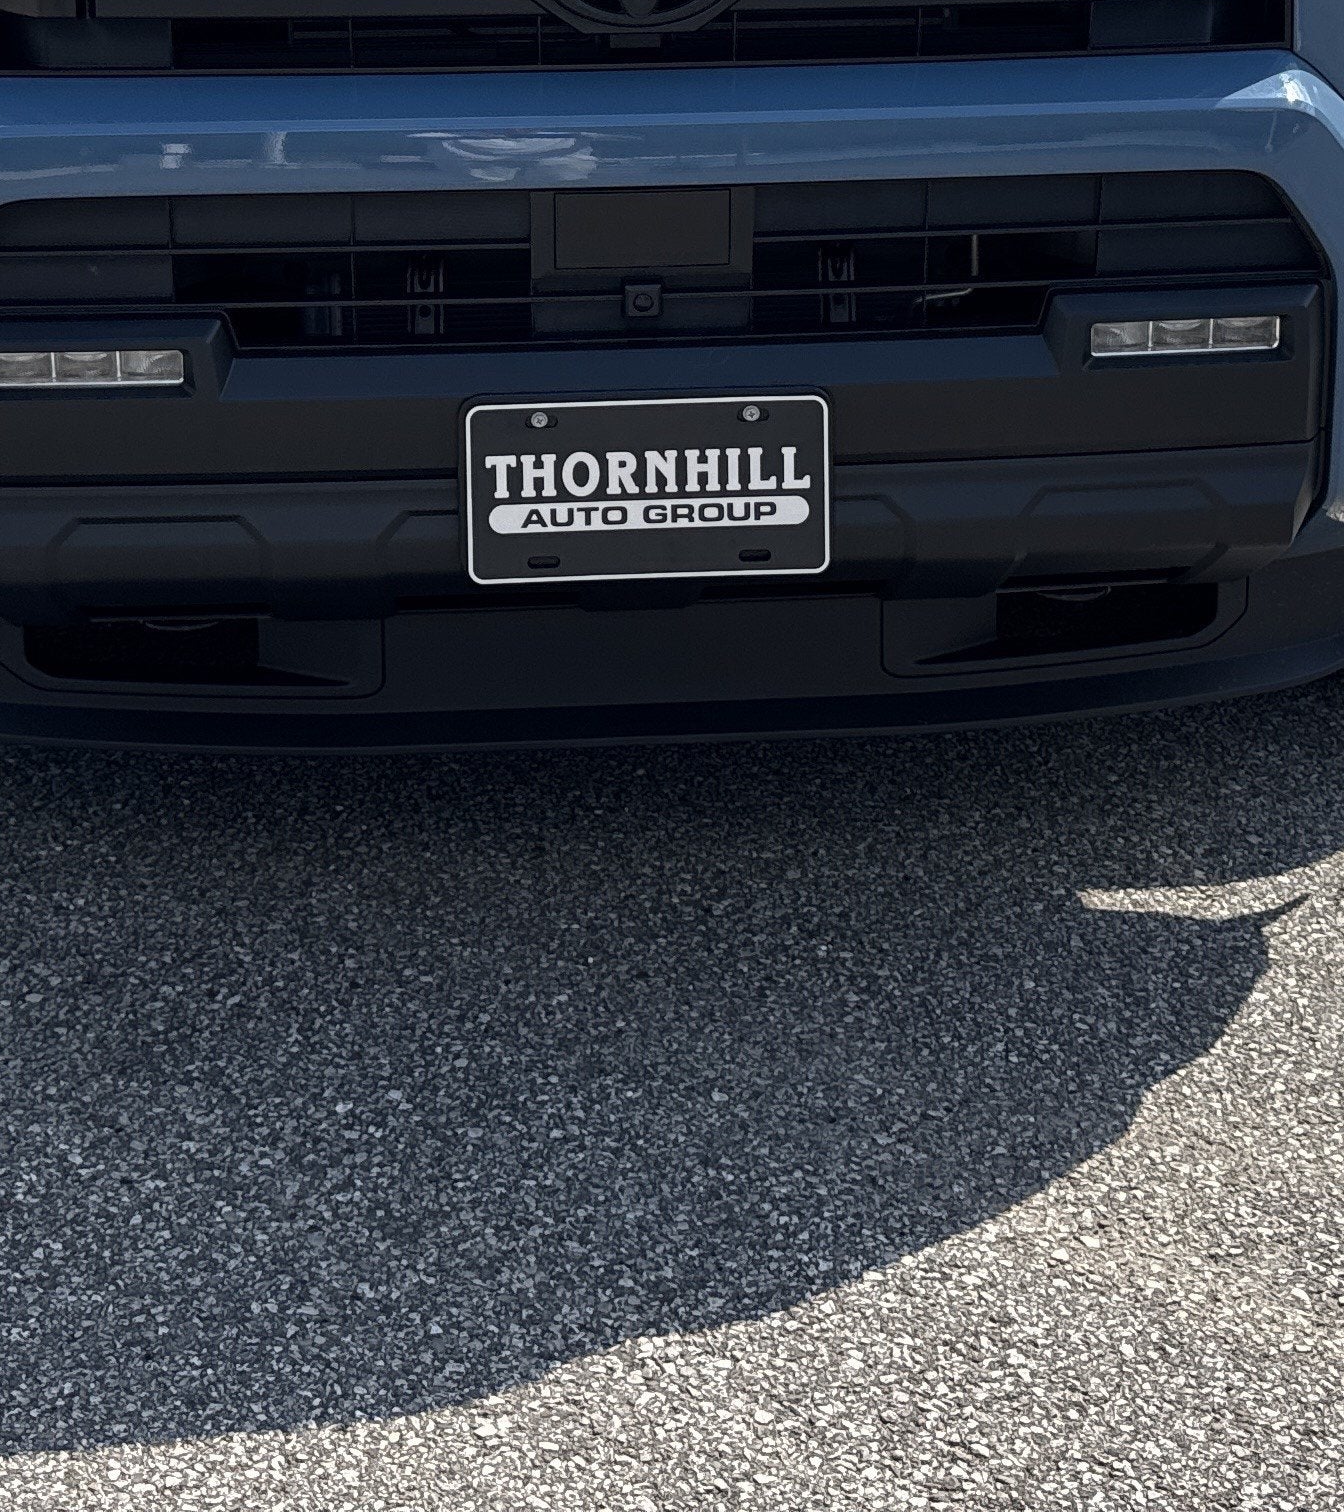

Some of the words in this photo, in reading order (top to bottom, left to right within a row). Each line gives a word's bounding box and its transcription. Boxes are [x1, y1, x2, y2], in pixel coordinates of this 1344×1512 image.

[485, 446, 811, 499] THORNHILL
[521, 505, 628, 529] AUTO
[642, 501, 777, 524] GROUP
